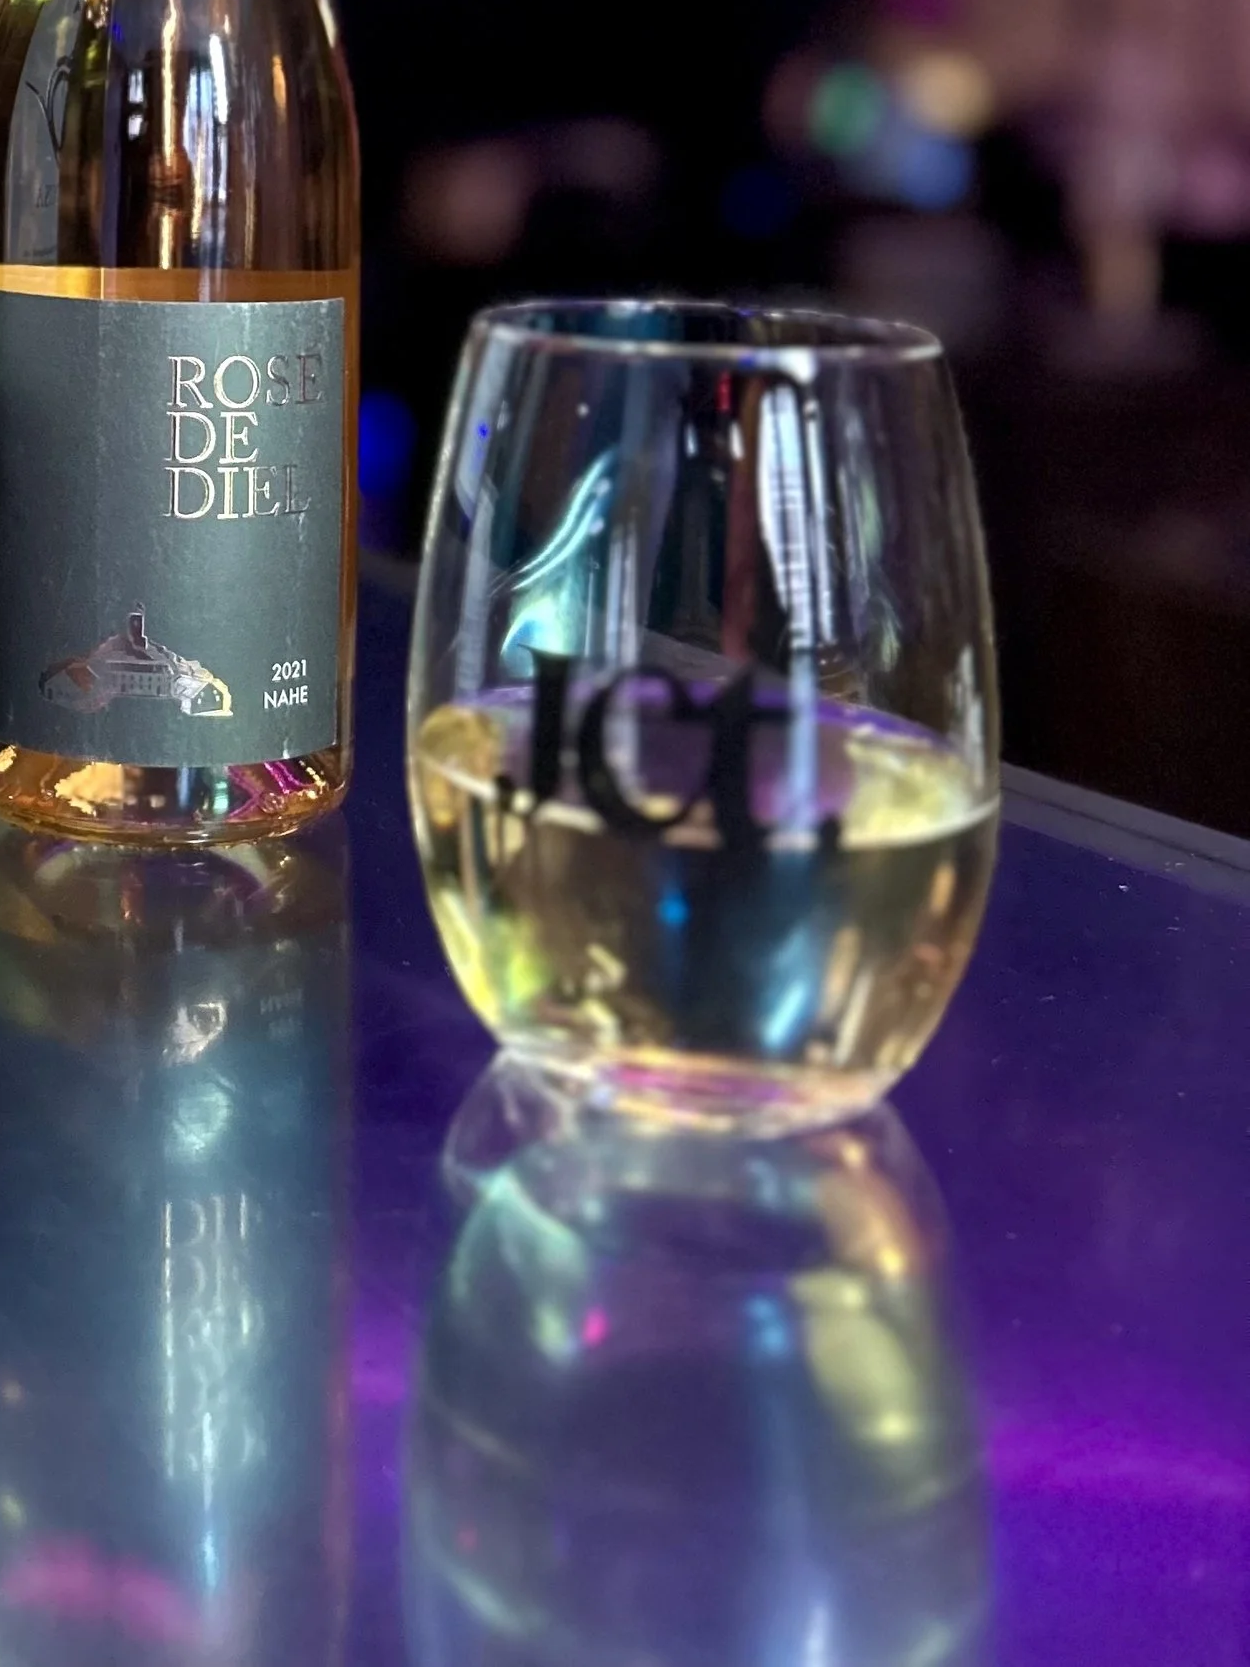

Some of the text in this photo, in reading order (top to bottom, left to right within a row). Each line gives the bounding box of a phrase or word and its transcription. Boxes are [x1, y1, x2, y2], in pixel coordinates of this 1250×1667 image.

[163, 410, 260, 466] DE
[162, 464, 312, 521] DIEL
[271, 659, 308, 683] 2021
[263, 685, 309, 710] NAHE
